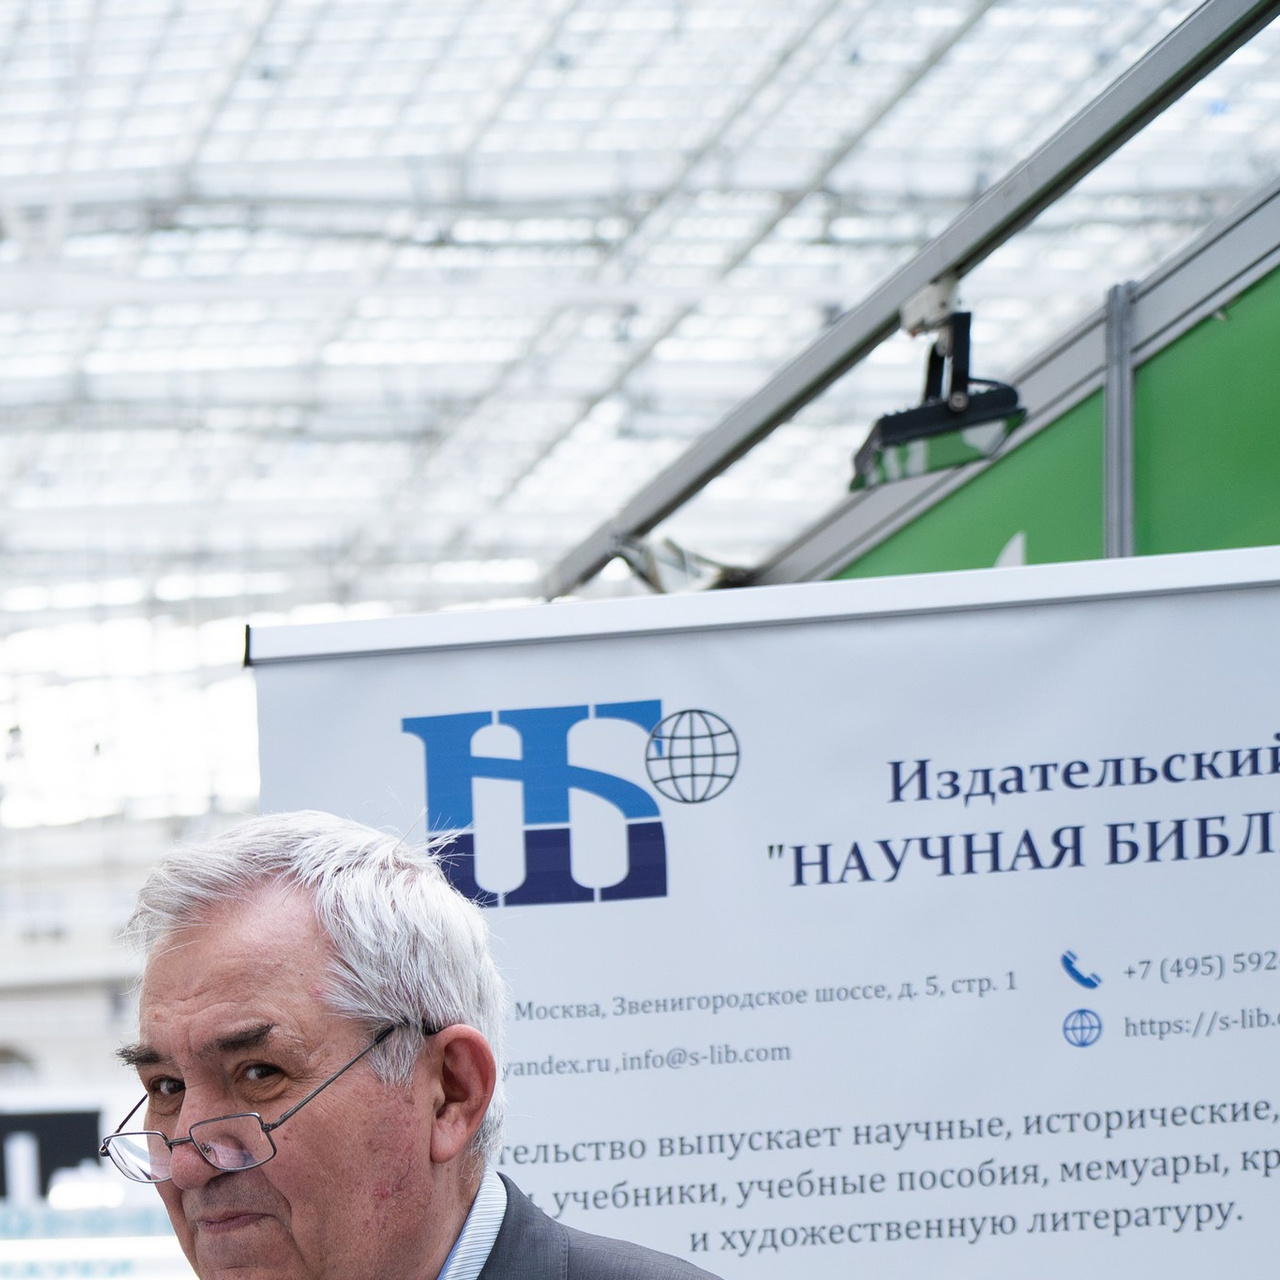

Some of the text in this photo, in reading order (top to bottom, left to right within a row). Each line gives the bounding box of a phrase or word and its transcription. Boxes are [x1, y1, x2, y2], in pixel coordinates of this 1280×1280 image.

[766, 810, 1280, 886] "НАУЧНАЯ БИБЛ
[1123, 950, 1280, 984] +7 (495) 592
[515, 970, 1017, 1021] Москва, Звенигородское шоссе, д. 5, стр. 1
[1124, 1008, 1280, 1040] https://s-lib.
[658, 1123, 842, 1160] выпускает
[852, 1114, 1013, 1150] научные,
[1022, 1099, 1280, 1138] исторические,
[552, 1181, 727, 1218] учебники,
[736, 1169, 886, 1208] учебные
[897, 1158, 1049, 1192] пособия,
[1059, 1152, 1230, 1186] мемуары,
[689, 1201, 1244, 1257] и художественную литературу.
